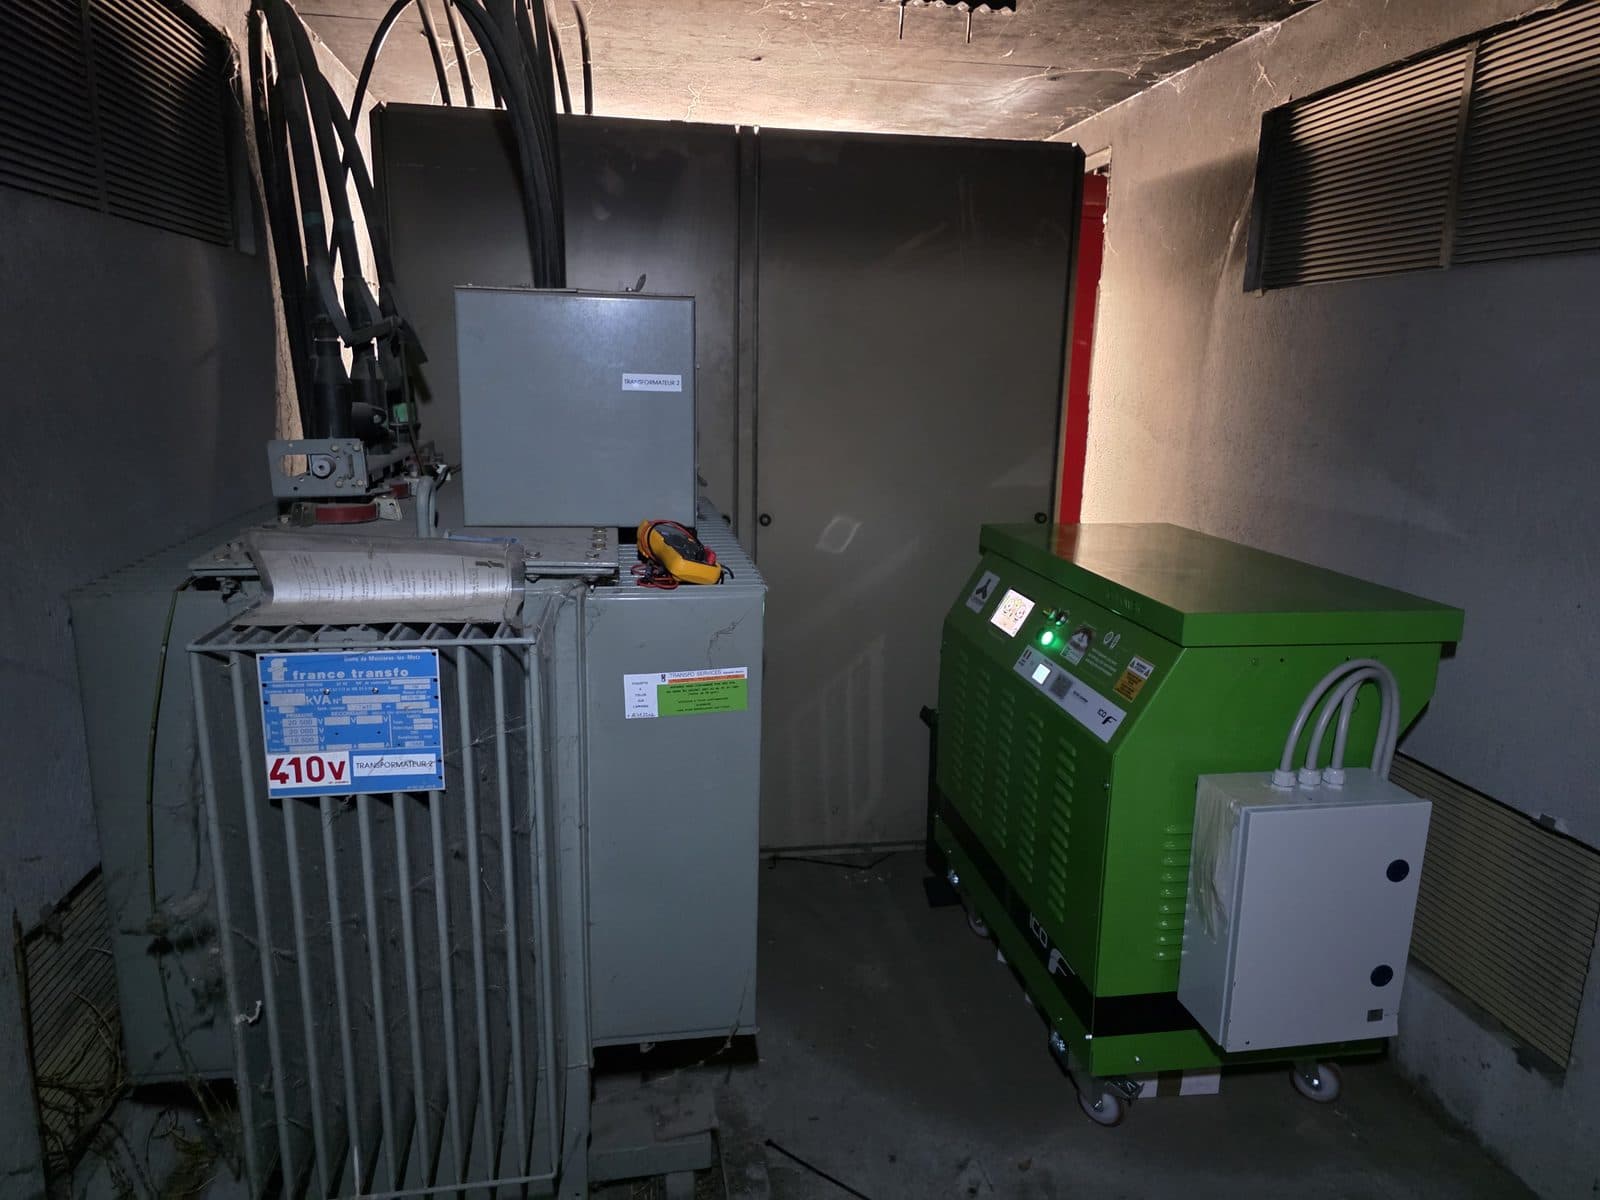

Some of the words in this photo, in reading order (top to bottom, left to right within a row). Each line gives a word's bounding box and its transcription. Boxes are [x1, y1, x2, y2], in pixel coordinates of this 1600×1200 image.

[292, 670, 346, 681] france
[351, 667, 409, 679] transfo
[305, 695, 331, 705] kVA
[356, 760, 427, 769] TRANSFORMATEUR
